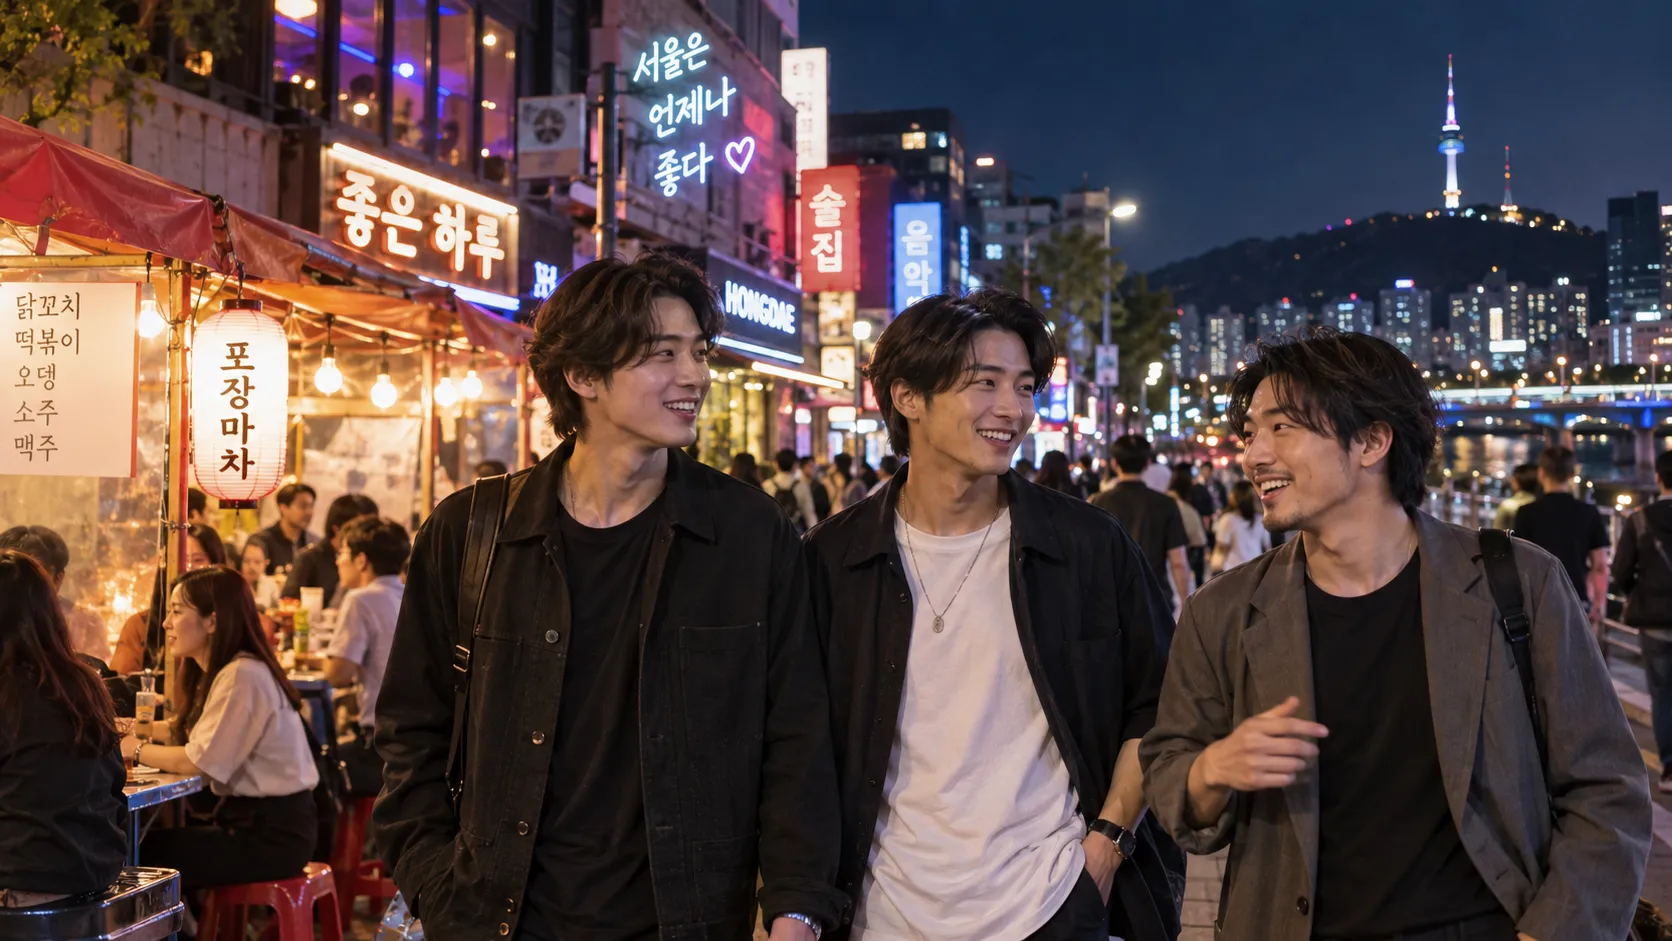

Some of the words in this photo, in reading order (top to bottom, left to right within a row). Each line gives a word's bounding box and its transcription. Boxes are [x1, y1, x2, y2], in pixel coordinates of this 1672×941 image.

[632, 32, 710, 83] 서울은
[649, 75, 737, 139] 언제나
[654, 141, 714, 197] 좋다
[336, 169, 423, 258] 좋은
[433, 203, 505, 280] 하루
[808, 184, 847, 273] 술집
[901, 219, 933, 306] 음악
[16, 292, 81, 320] 닭꼬치
[725, 279, 796, 335] HONGDAE
[15, 328, 80, 356] 떡볶이
[14, 363, 56, 391] 오뎅
[13, 400, 59, 427] 소주
[219, 341, 256, 481] 포장마차
[14, 433, 59, 462] 맥주
